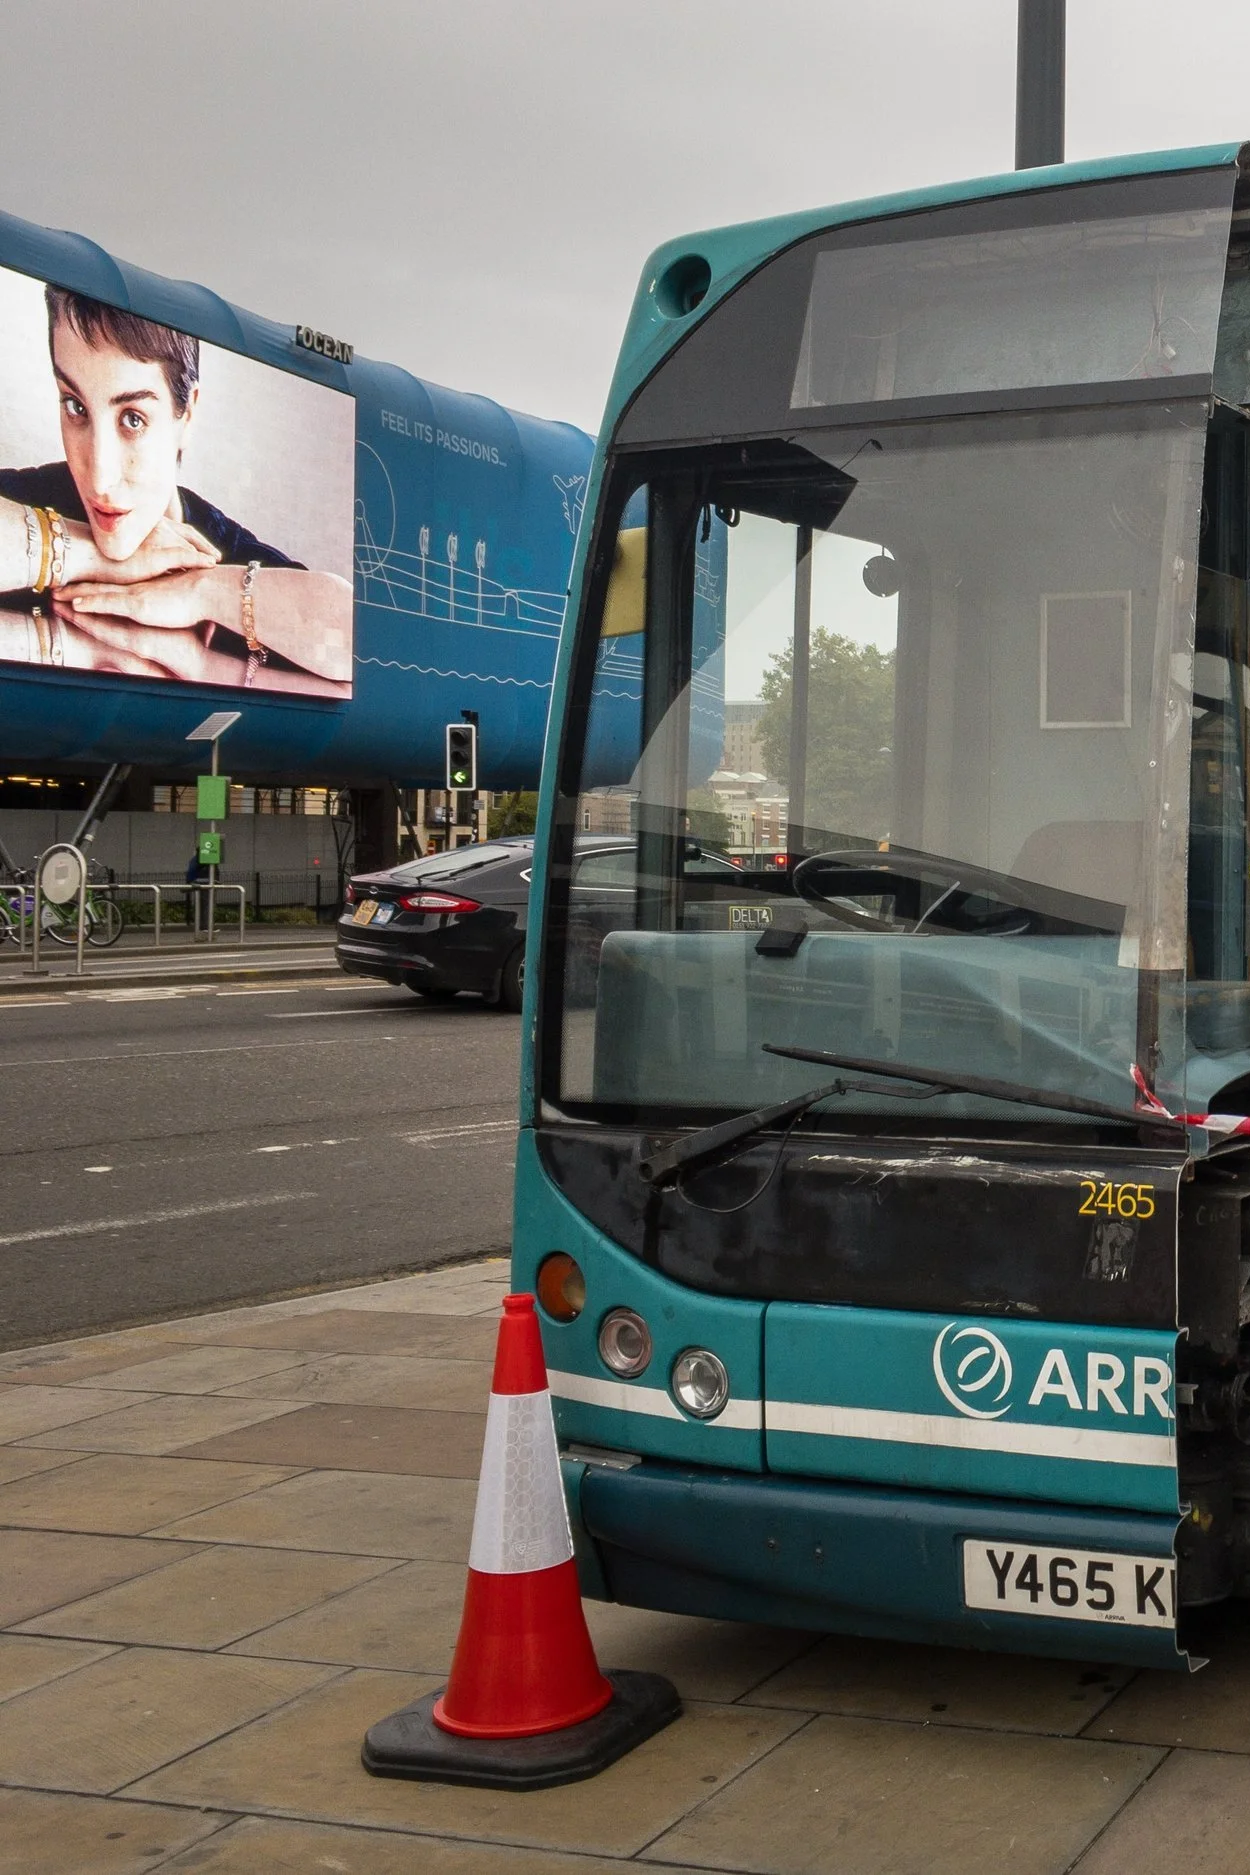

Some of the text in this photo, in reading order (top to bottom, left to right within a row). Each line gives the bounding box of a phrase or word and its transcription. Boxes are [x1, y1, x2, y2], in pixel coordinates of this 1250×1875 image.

[302, 326, 354, 364] OCEAN
[381, 409, 411, 437] FEEL
[415, 422, 433, 443] ITS
[732, 908, 770, 923] DELTA
[1078, 1180, 1155, 1219] 2465
[1028, 1348, 1175, 1418] ARR
[986, 1549, 1177, 1618] Y465 K
